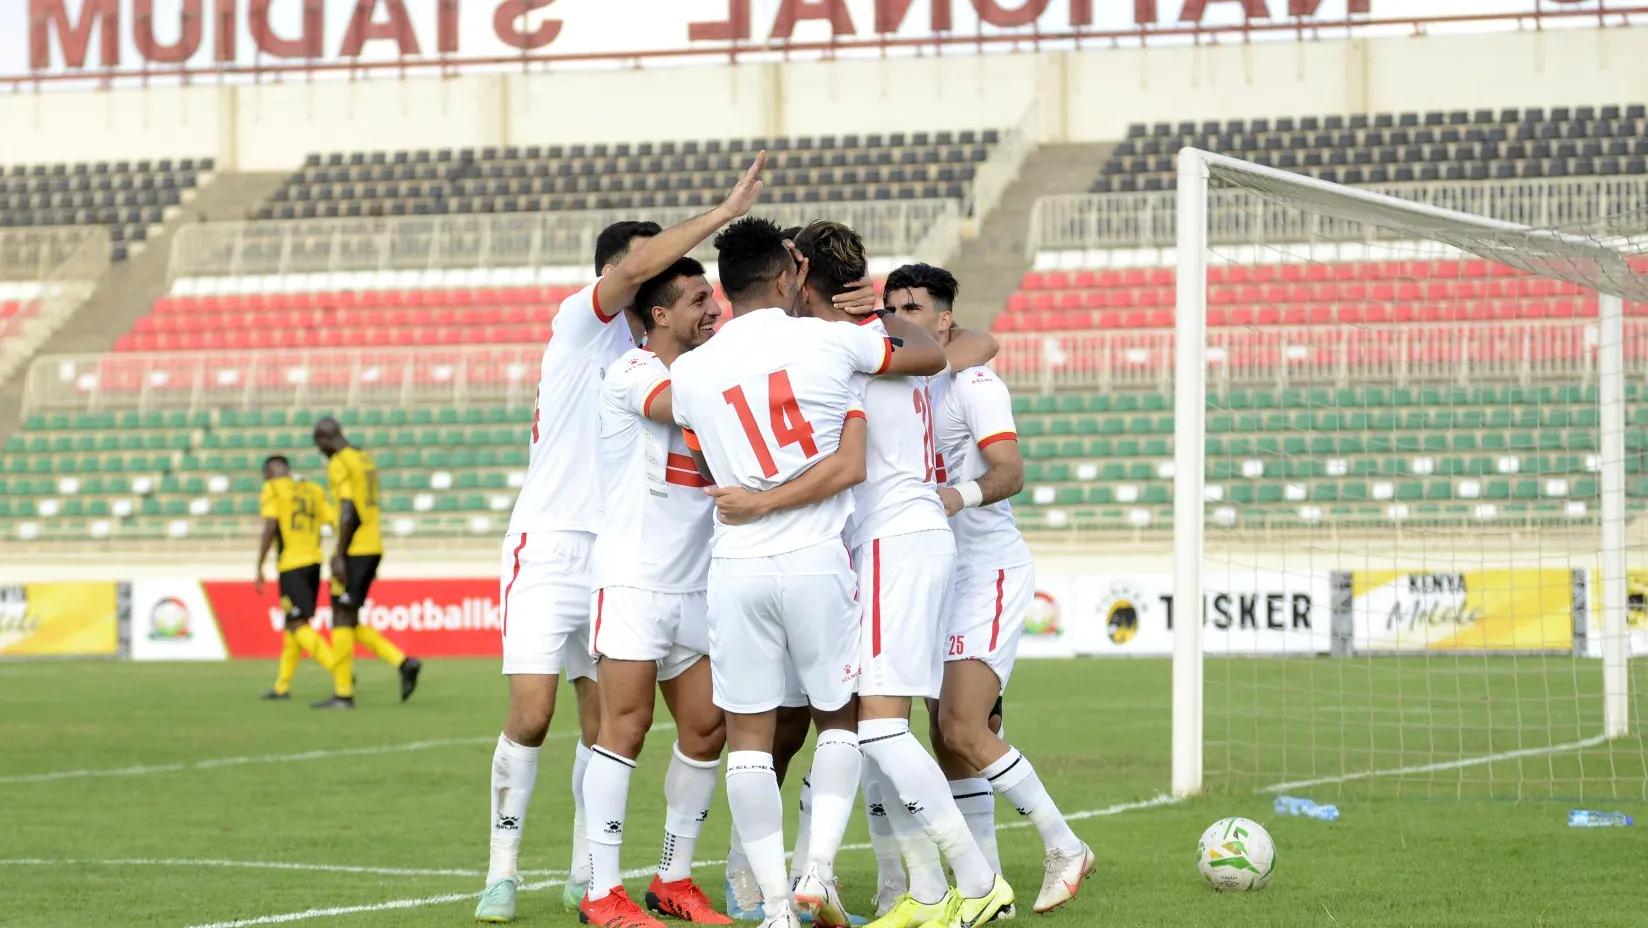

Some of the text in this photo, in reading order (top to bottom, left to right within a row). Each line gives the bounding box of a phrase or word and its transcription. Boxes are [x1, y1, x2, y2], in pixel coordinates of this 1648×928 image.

[722, 369, 819, 479] 14
[1159, 594, 1312, 630] TSKER
[949, 635, 965, 656] 25
